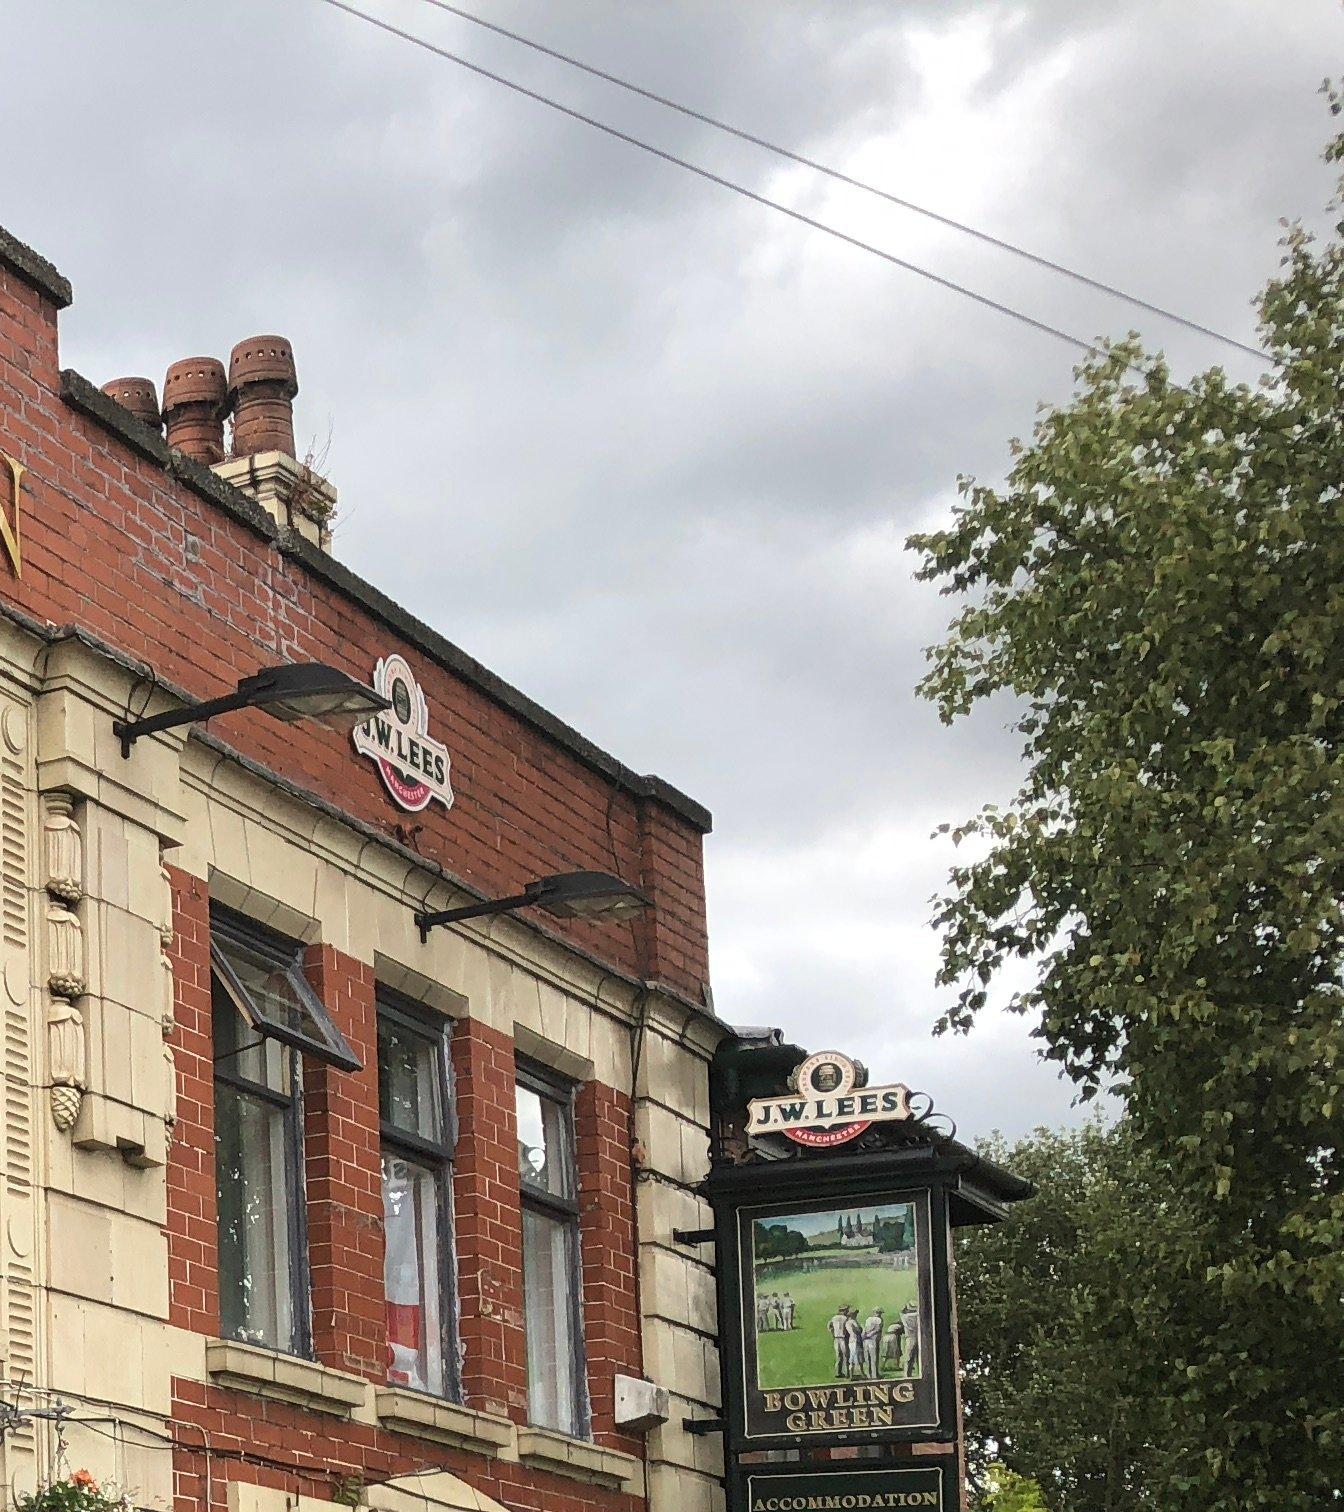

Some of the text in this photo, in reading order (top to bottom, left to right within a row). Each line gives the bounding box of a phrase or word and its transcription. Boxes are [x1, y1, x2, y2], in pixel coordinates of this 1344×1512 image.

[795, 1124, 861, 1143] MANCHESTER
[764, 1382, 915, 1413] BOWLING
[786, 1405, 894, 1432] GREEN
[752, 1491, 938, 1512] ACCOMMODATION
